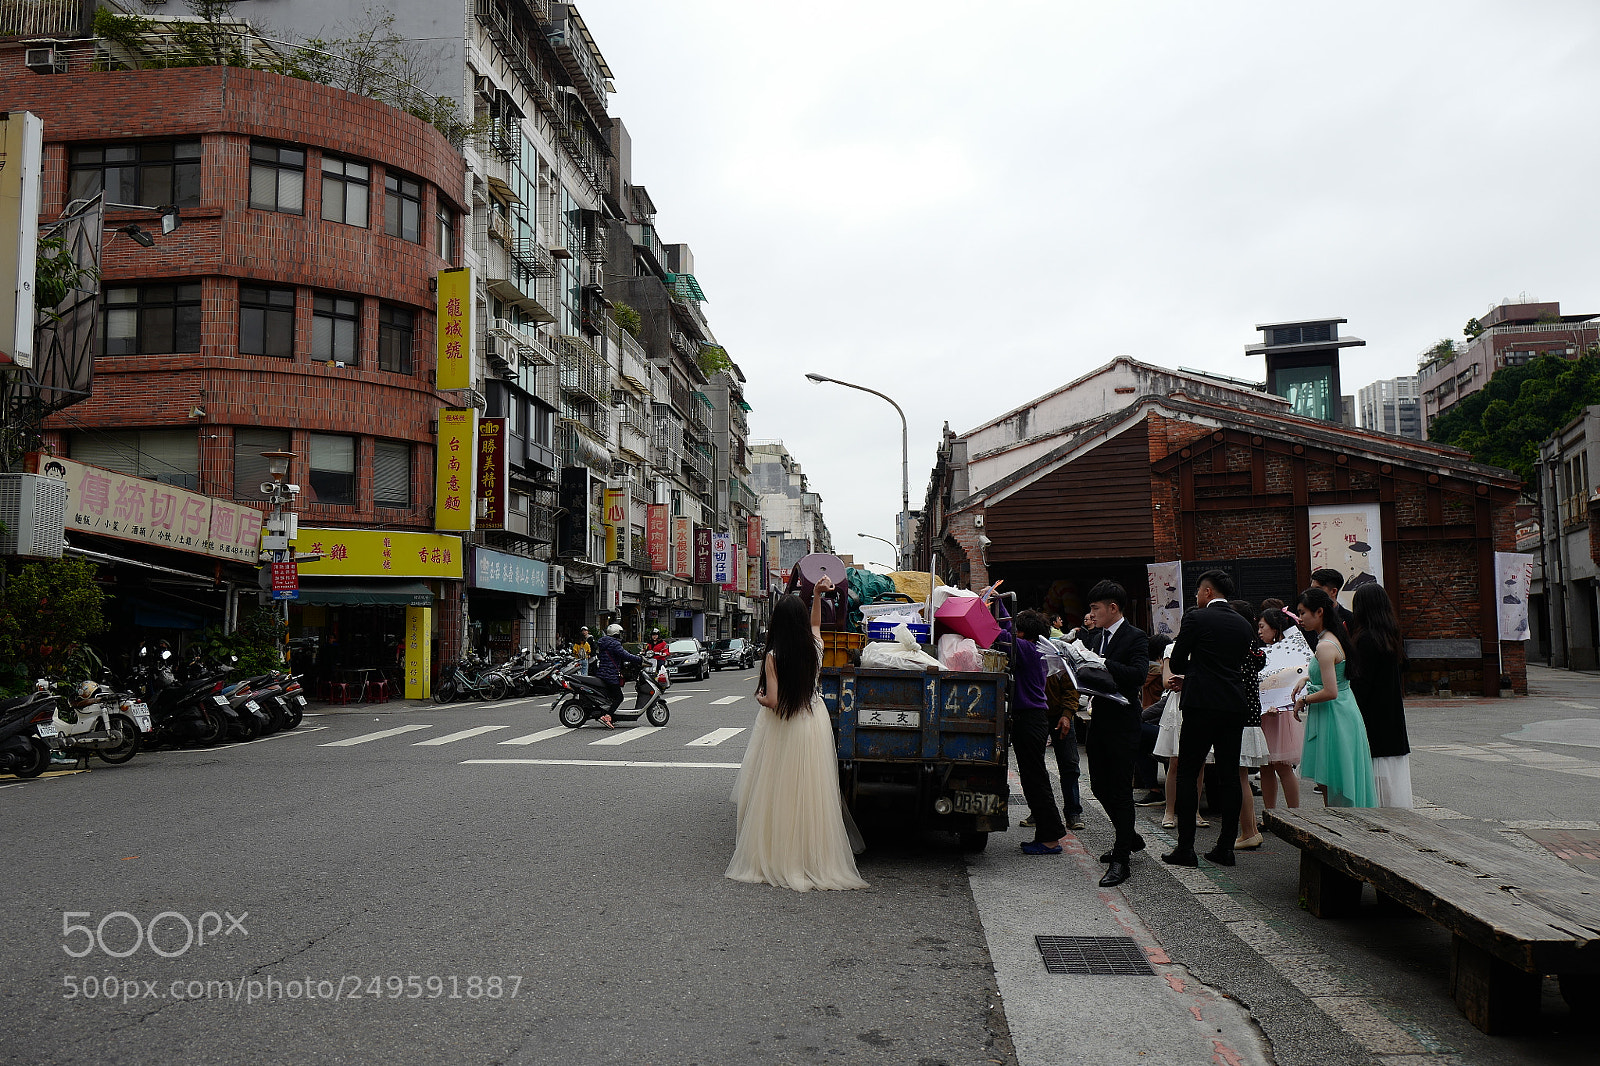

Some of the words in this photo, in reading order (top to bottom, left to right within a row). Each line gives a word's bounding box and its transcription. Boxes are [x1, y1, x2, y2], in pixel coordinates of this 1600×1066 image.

[445, 298, 463, 360] 龍城號
[444, 437, 461, 512] 台南意麵
[78, 471, 262, 547] 傳統切仔麵店
[608, 494, 625, 521] 一心
[419, 547, 452, 566] 香菇雞
[677, 520, 688, 573] 黃水根診所
[715, 552, 726, 583] 切仔麵
